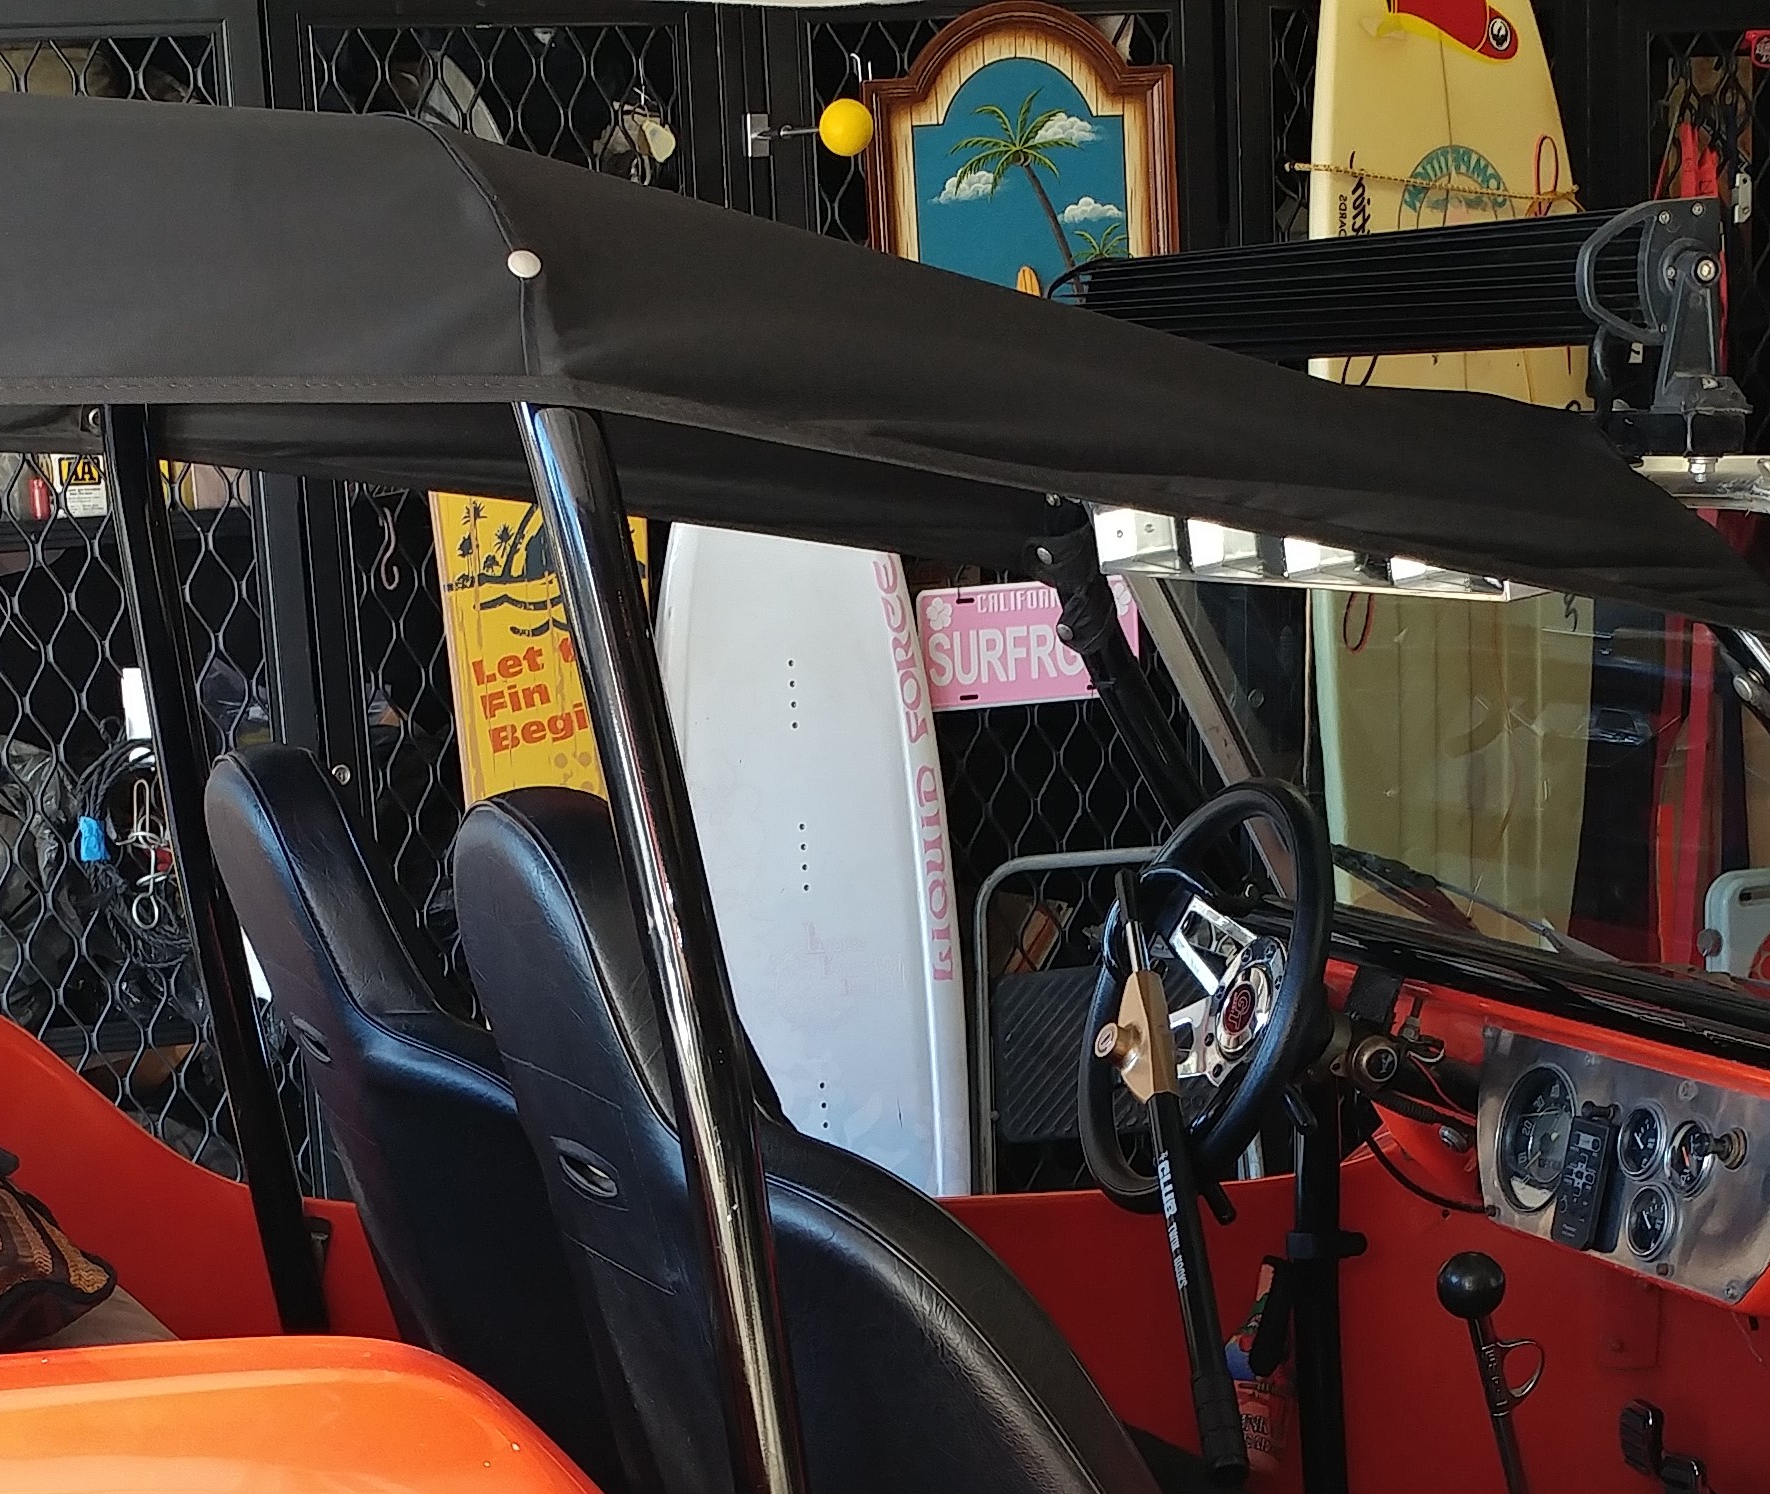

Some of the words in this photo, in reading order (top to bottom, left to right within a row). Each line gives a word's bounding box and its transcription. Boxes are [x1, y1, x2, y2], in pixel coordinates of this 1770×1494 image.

[976, 588, 1063, 613] CALIFORN
[472, 646, 545, 686] Let
[872, 552, 928, 744] FORCE
[929, 623, 1087, 687] SURFRG
[480, 683, 551, 720] Fin
[489, 702, 589, 753] Begi
[917, 765, 953, 981] LIQUID
[1158, 1159, 1178, 1220] CLUB
